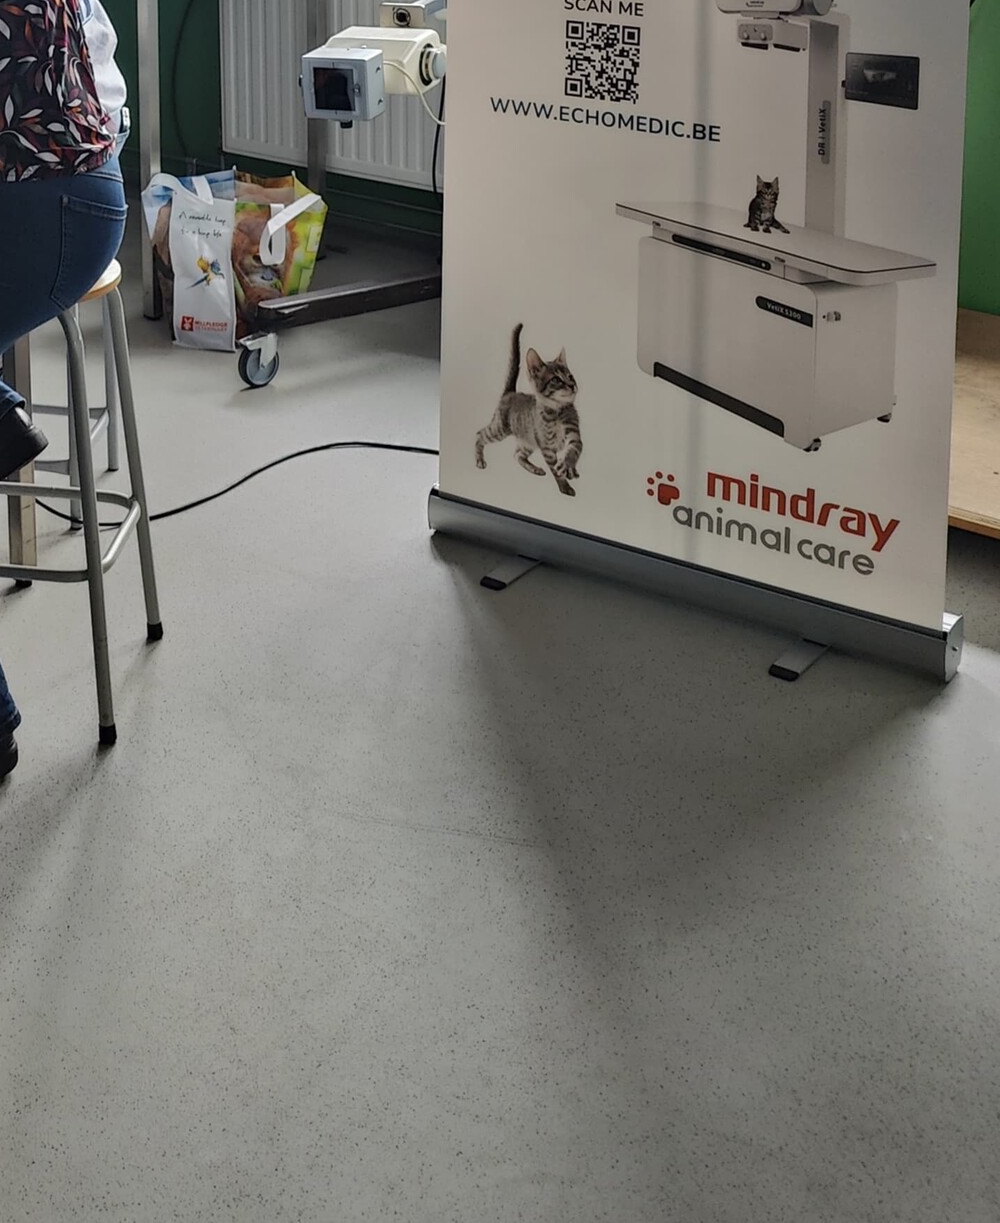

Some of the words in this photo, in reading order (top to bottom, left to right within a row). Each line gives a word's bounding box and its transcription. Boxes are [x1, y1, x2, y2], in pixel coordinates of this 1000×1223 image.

[618, 1, 644, 17] ME
[490, 96, 721, 142] WWW.ECHOMEDIC.BE
[818, 142, 826, 156] DR
[707, 471, 900, 553] mindray
[672, 505, 791, 555] animal
[797, 538, 875, 576] care
